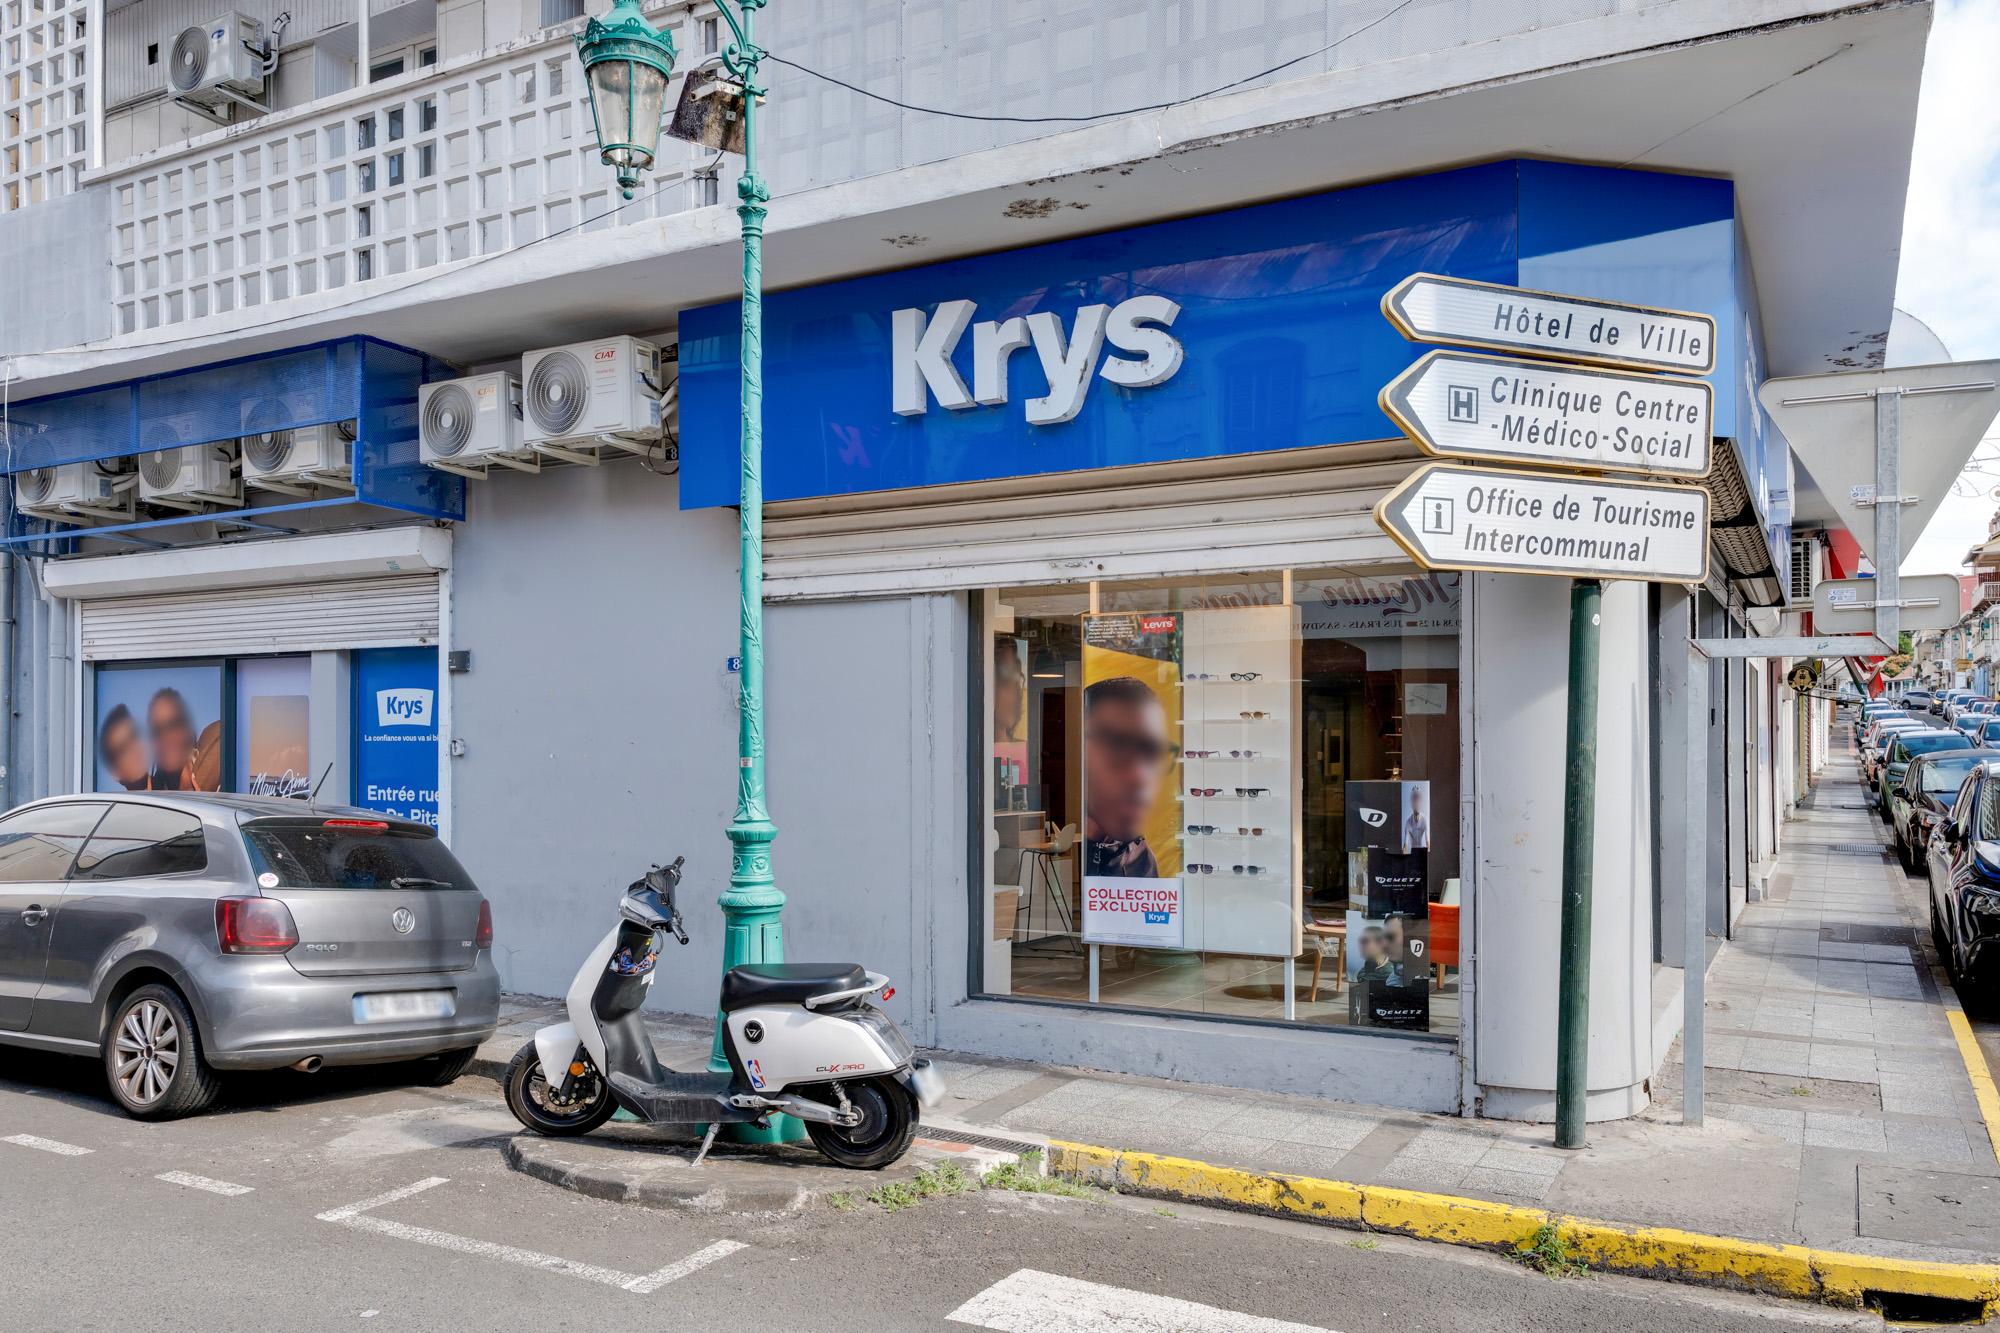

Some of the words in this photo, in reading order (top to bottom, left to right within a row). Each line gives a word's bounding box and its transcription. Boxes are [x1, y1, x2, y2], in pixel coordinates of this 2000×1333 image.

[1493, 303, 1574, 340] Hôtel
[1589, 317, 1620, 346] de
[1640, 323, 1702, 357] Ville
[594, 350, 616, 361] CIAT
[892, 295, 1185, 426] Krys
[1491, 376, 1602, 418] Clinique
[1615, 390, 1699, 424] Centre
[1491, 414, 1692, 459] -Médico-Social
[1466, 486, 1542, 518] Office
[1553, 491, 1580, 521] de
[1593, 496, 1695, 530] Tourisme
[1464, 523, 1650, 562] Intercommunal
[386, 696, 423, 718] Krys
[364, 734, 372, 742] La
[373, 733, 402, 742] confiance
[426, 734, 432, 742] si
[367, 785, 416, 802] Entrée
[419, 790, 439, 802] rue
[1088, 888, 1178, 901] COLLECTION
[1088, 900, 1178, 914] EXCLUSIVE
[1148, 913, 1166, 922] Krys
[305, 943, 338, 952] POLO
[842, 1063, 865, 1071] PRO
